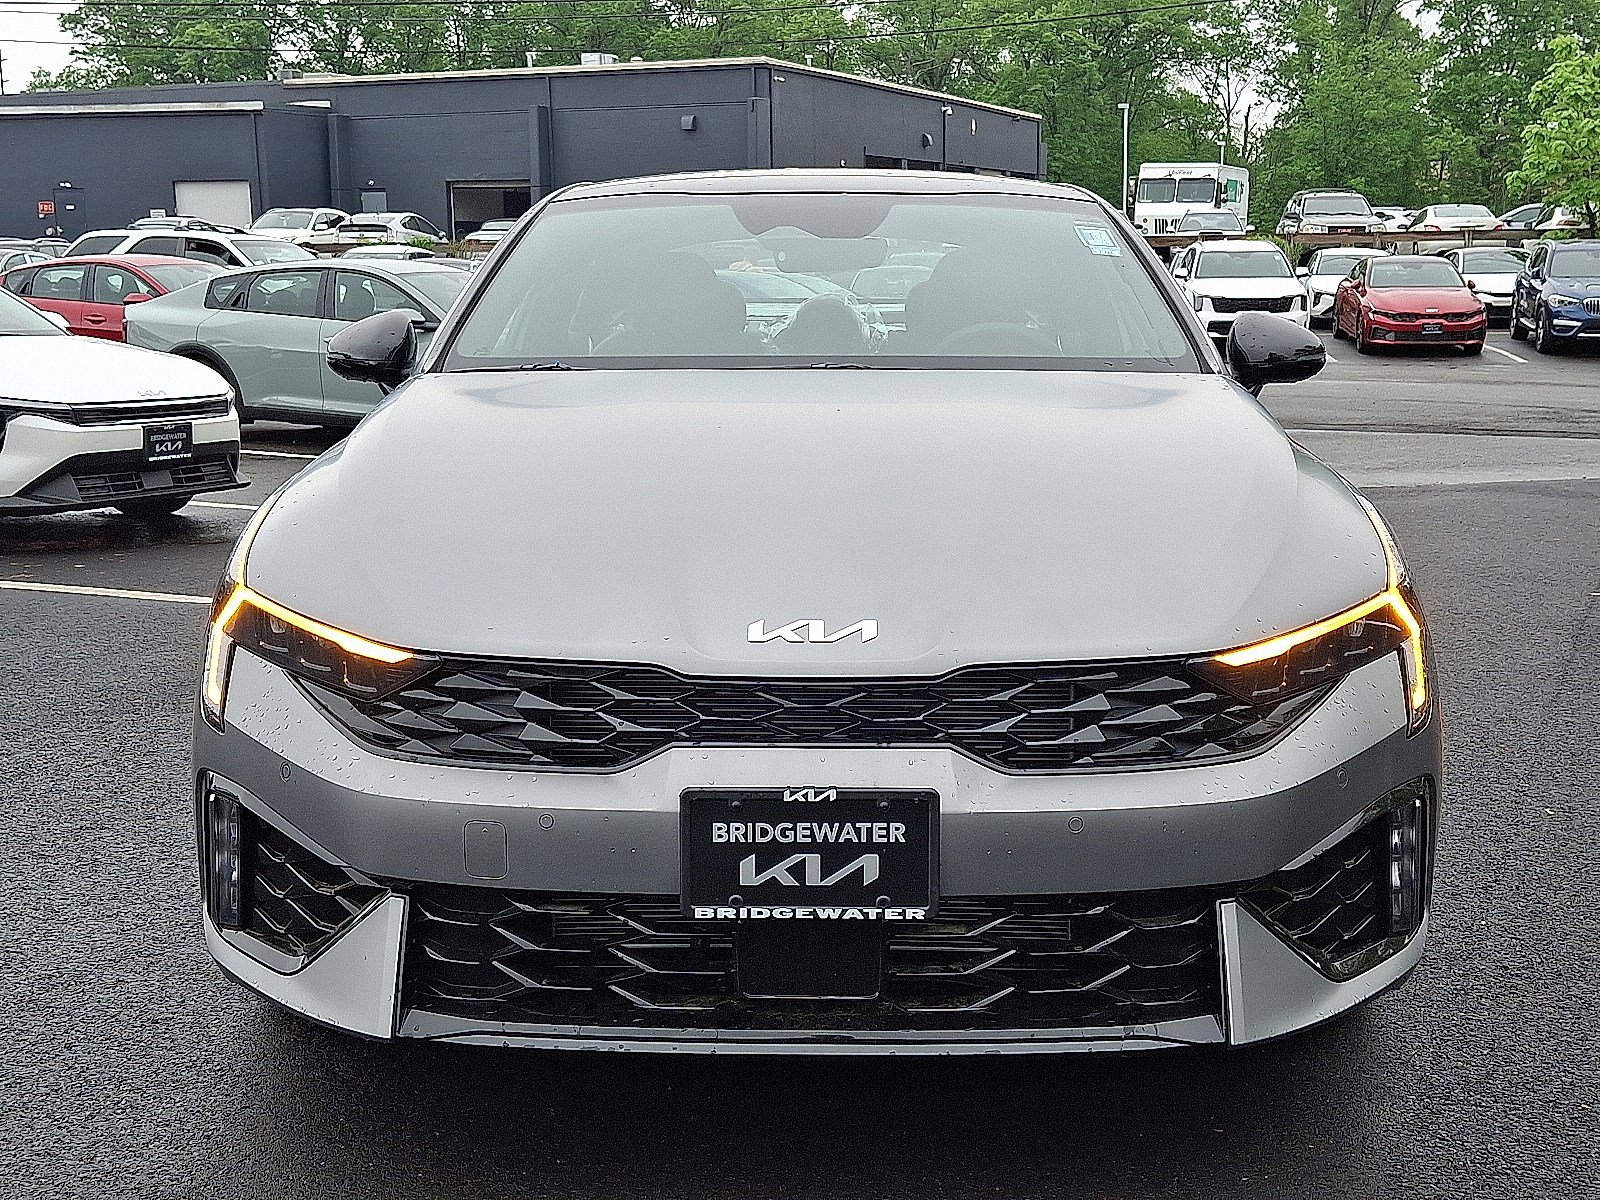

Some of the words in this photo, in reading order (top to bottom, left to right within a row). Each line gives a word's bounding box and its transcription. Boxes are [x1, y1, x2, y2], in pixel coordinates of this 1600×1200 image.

[155, 441, 182, 452] KIA
[747, 619, 878, 642] KIA
[783, 786, 838, 802] KIA
[712, 822, 907, 843] BRIDGEWATER
[739, 854, 880, 887] KIA
[694, 907, 927, 921] BRIDGEWATER
